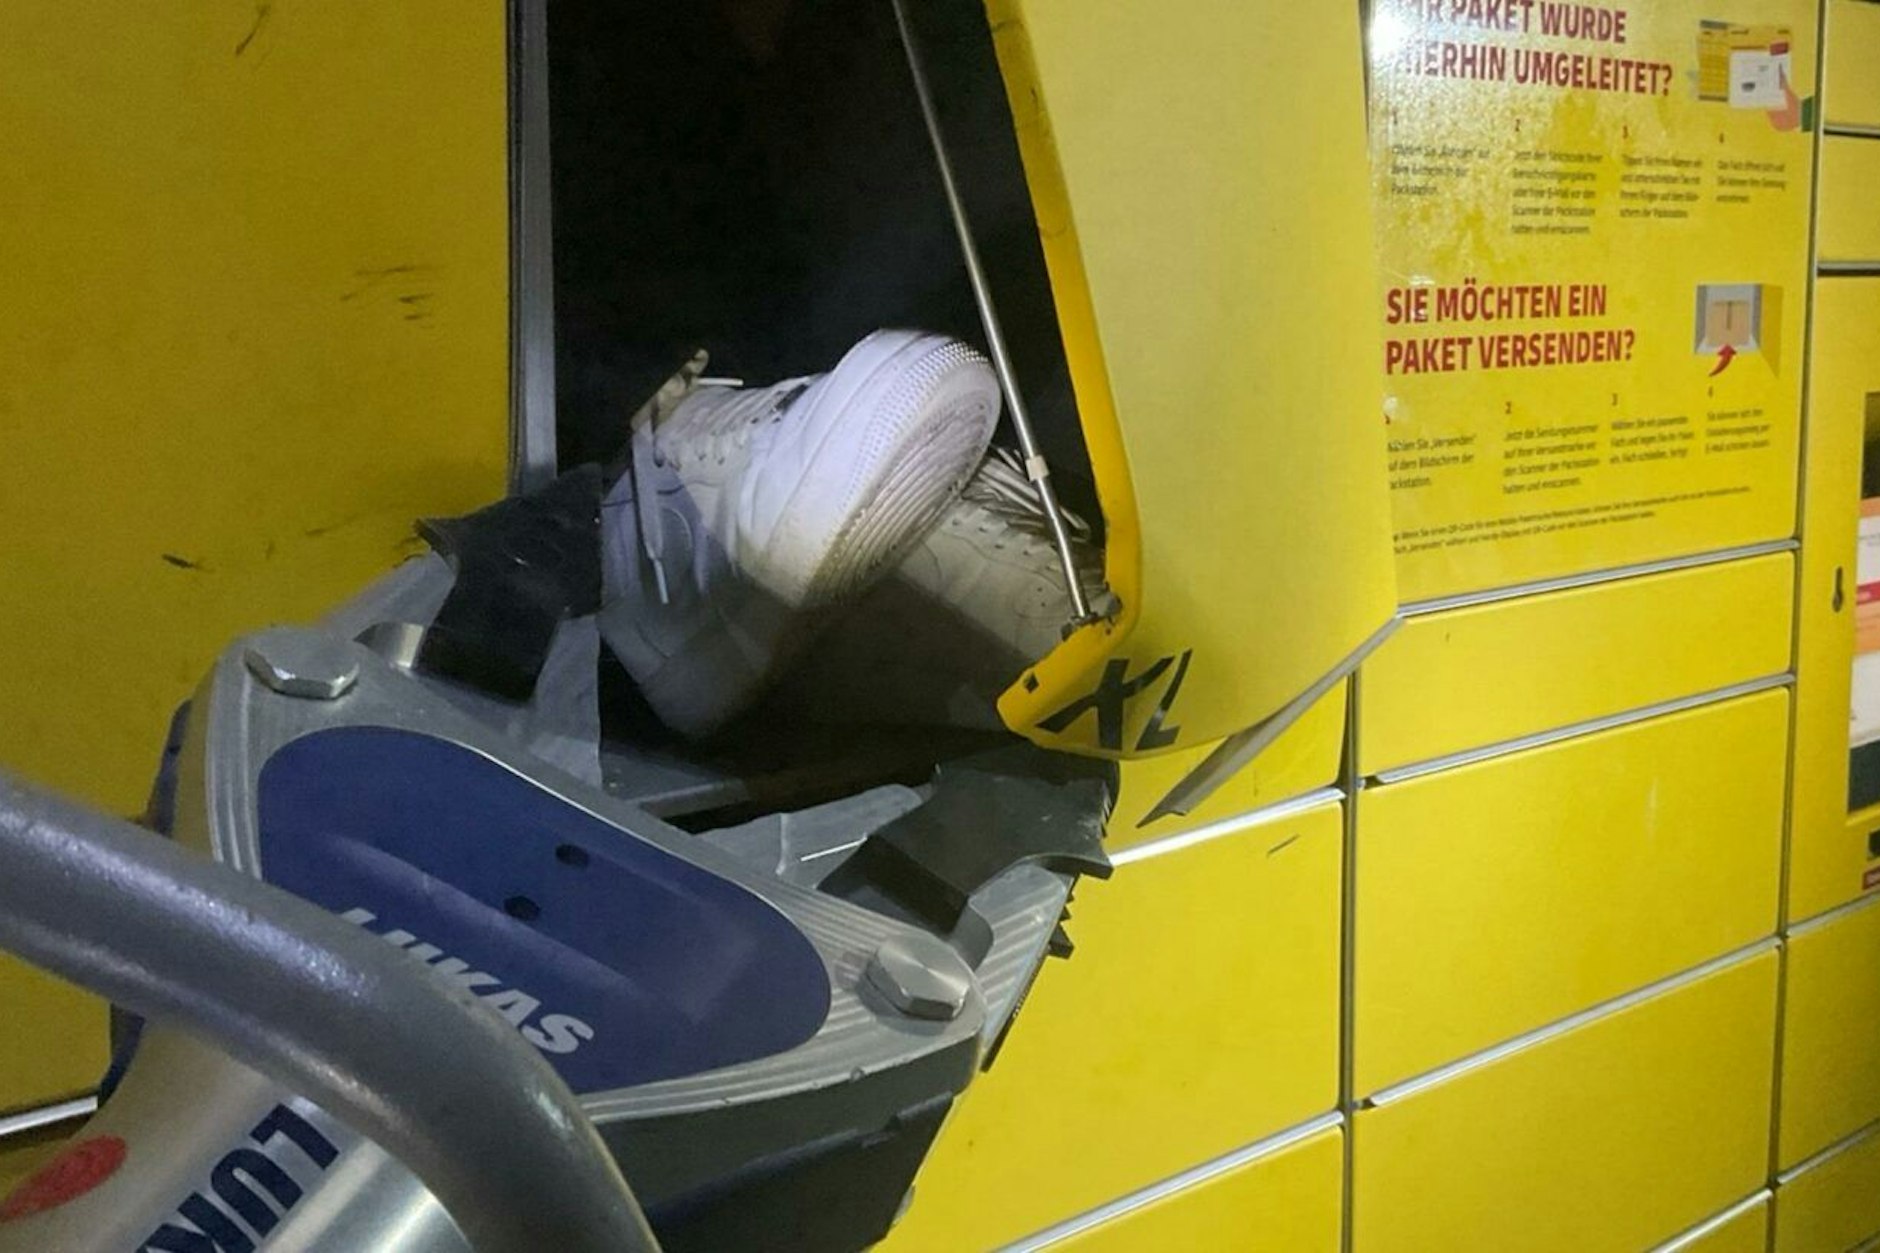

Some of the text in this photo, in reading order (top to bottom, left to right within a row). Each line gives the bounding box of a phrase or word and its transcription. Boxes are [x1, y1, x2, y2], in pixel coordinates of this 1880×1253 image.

[1450, 0, 1534, 34] PAKET
[1540, 2, 1627, 43] WURDE
[1397, 40, 1673, 96] IERHIN UMGELEITET?
[1387, 277, 1607, 324] SIE MÖCHTEN EIN
[1386, 329, 1635, 375] PAKET VERSENDEN?
[1035, 649, 1188, 752] XL
